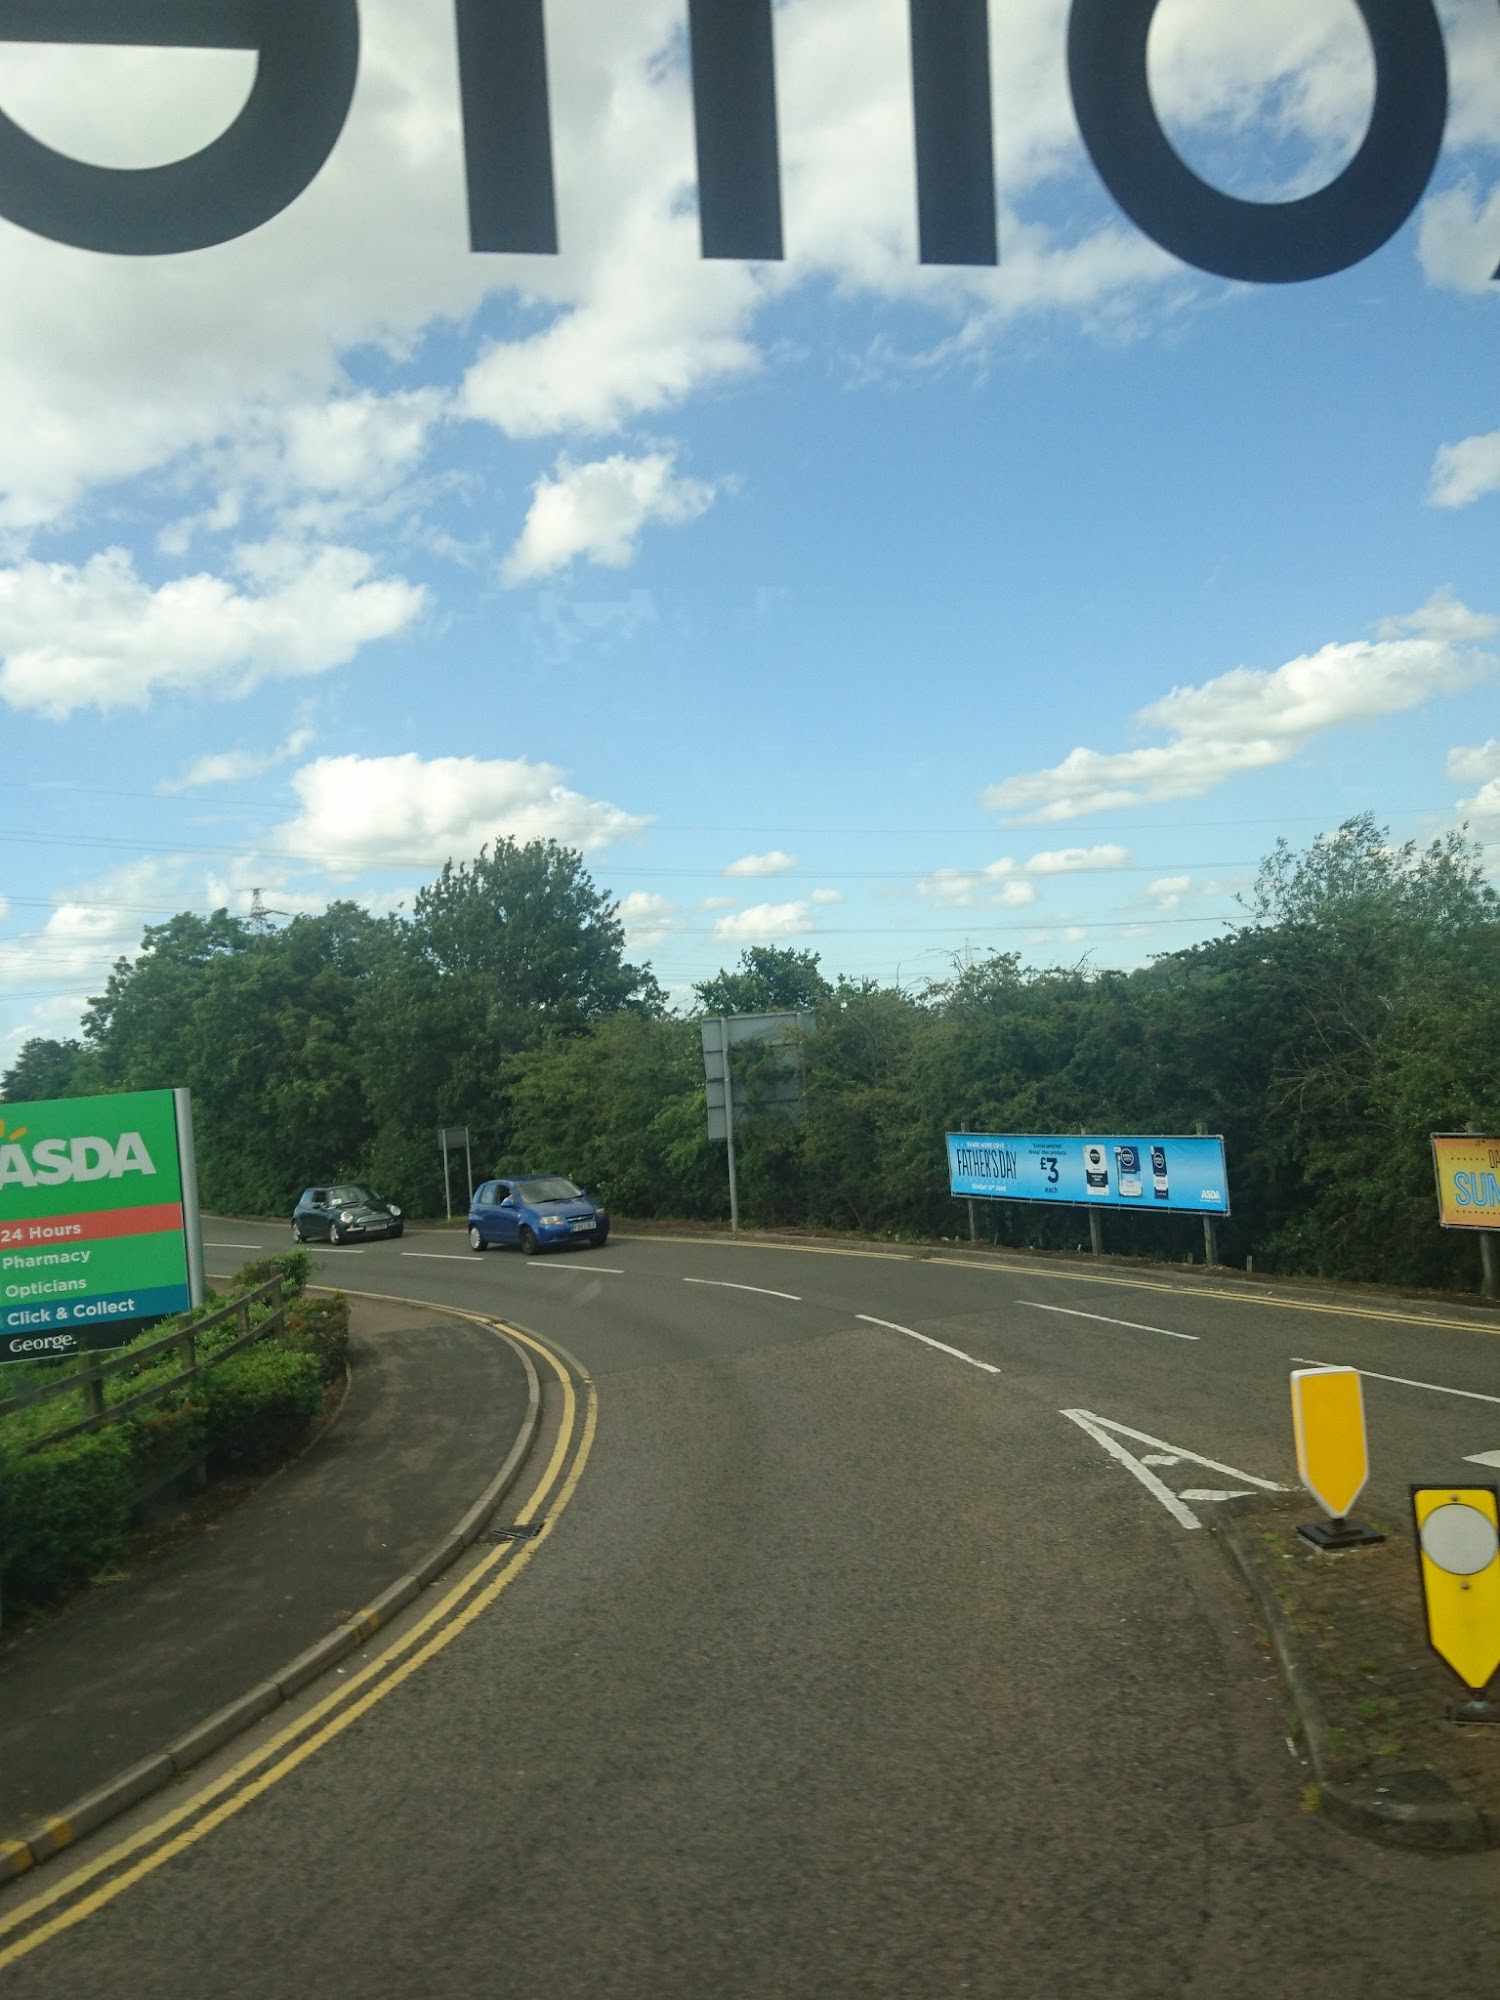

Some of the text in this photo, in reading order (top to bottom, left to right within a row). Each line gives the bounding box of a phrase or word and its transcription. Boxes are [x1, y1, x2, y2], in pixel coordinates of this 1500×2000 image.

[0, 1131, 156, 1190] ASDA
[957, 1149, 1017, 1179] FATHER'S DAY
[1201, 1189, 1221, 1199] ASDA
[1, 1224, 82, 1242] 24 Hours
[2, 1249, 91, 1270] Pharmacy
[5, 1278, 87, 1299] Opticians
[7, 1298, 135, 1326] Click & Collect
